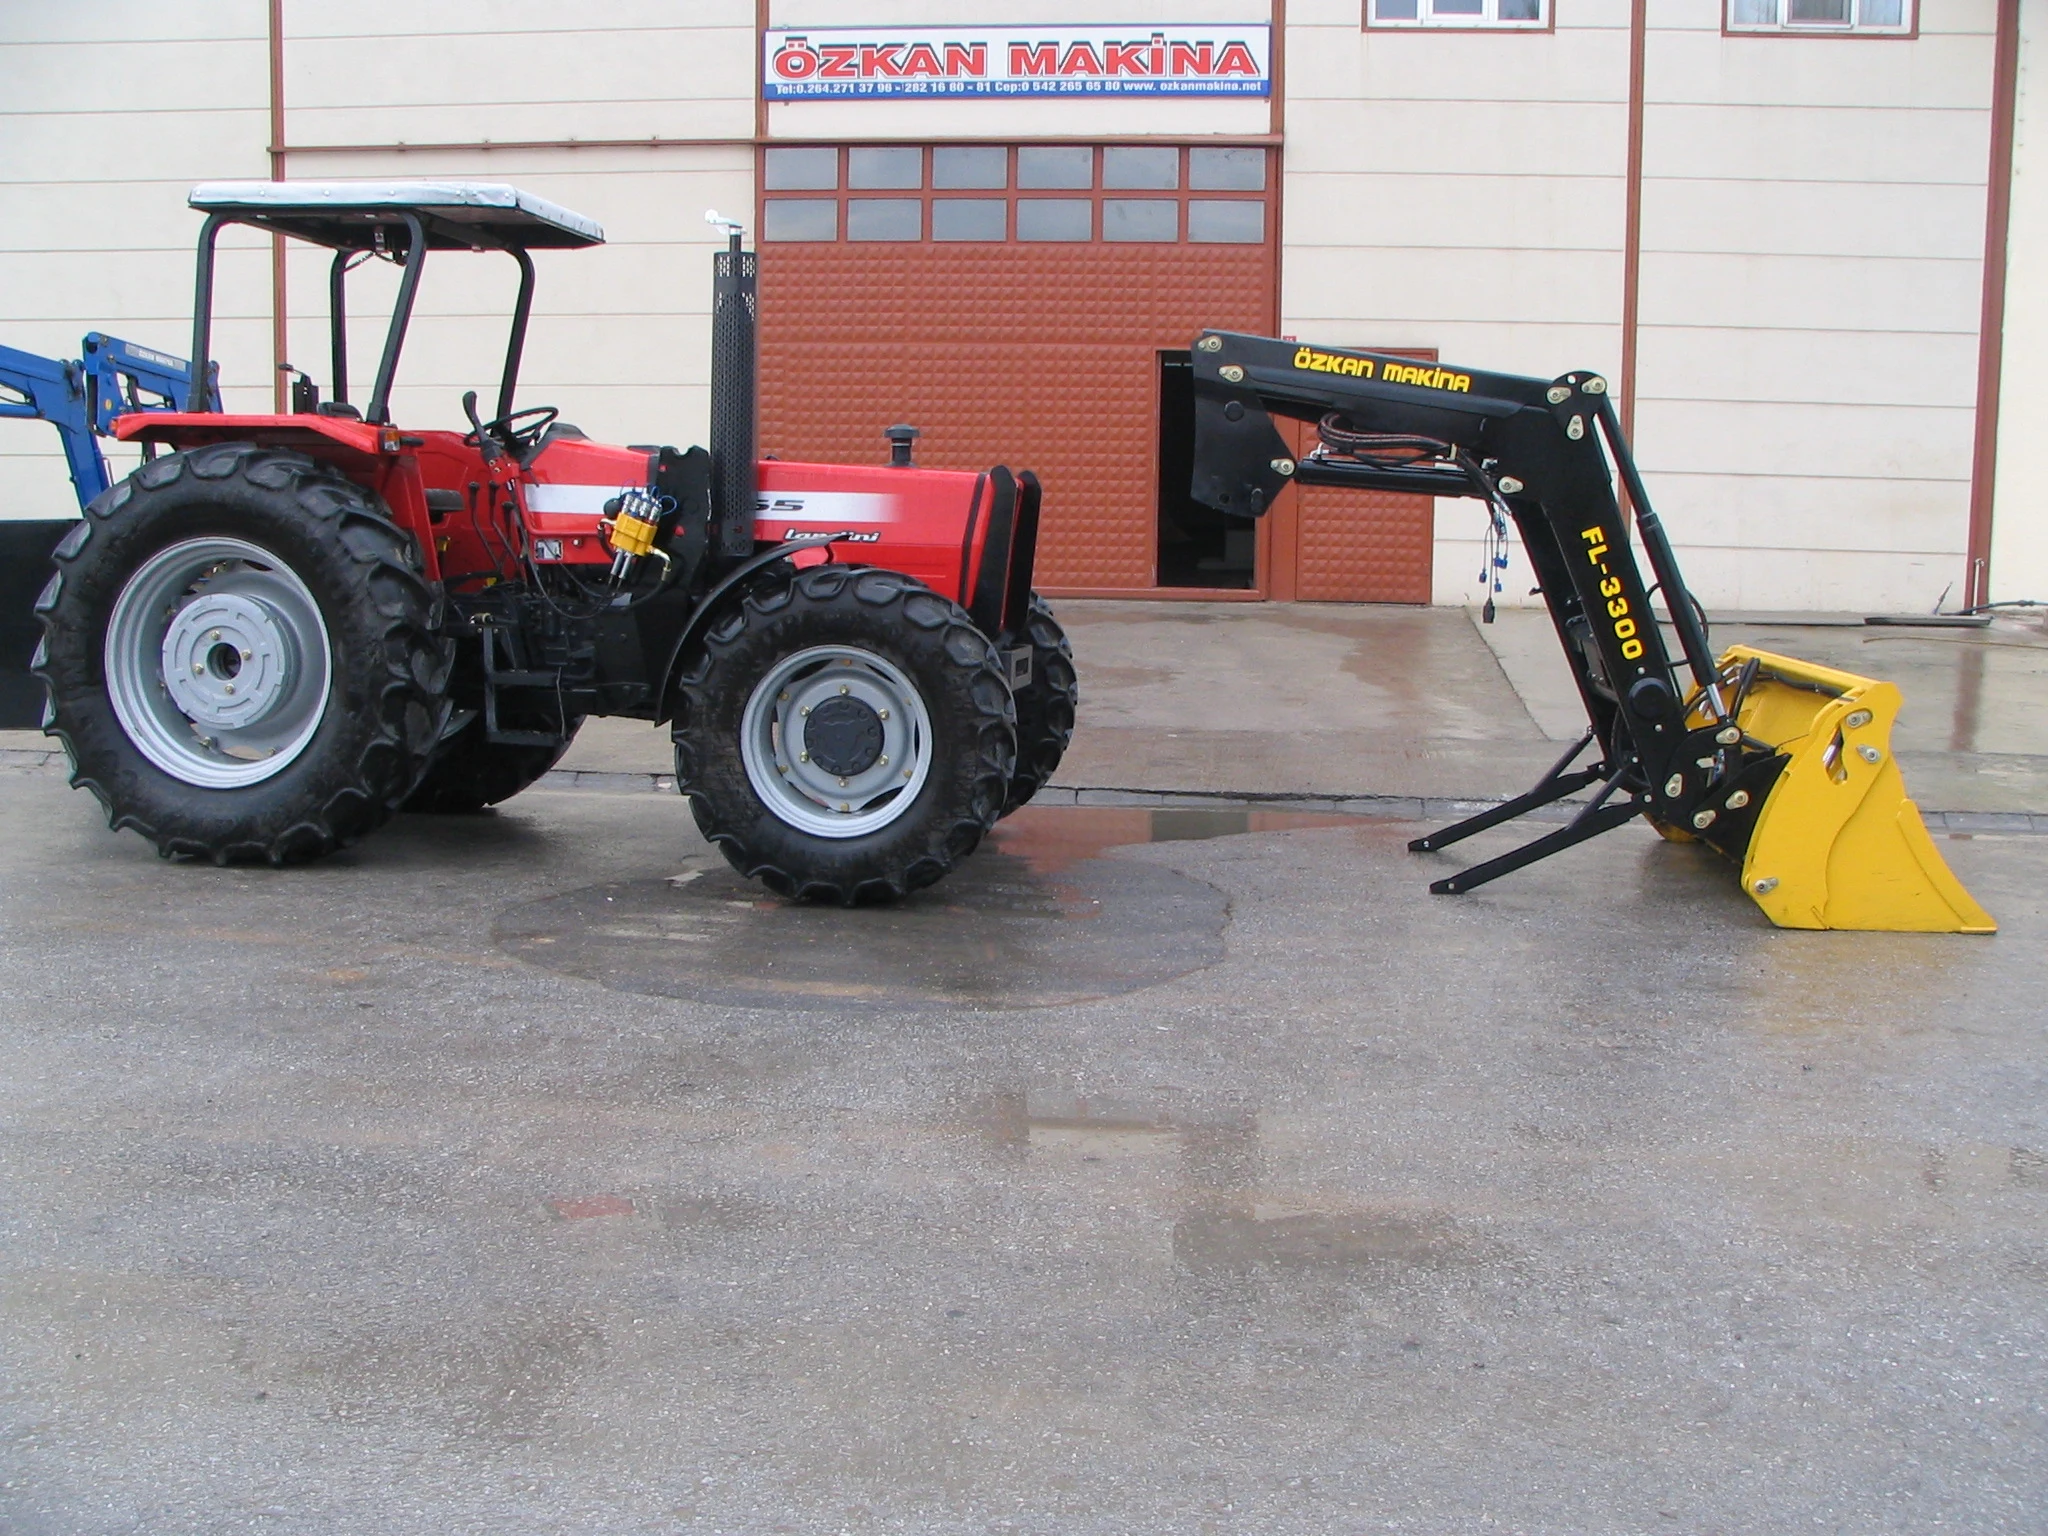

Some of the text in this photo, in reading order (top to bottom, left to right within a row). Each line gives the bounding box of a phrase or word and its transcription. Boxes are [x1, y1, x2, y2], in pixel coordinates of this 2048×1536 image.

[773, 33, 1261, 80] ÖZKAN MAKİNA
[858, 83, 874, 94] 37
[1032, 81, 1056, 92] 542
[1294, 346, 1374, 379] ÖZKAN
[1581, 525, 1643, 660] FL-3300
